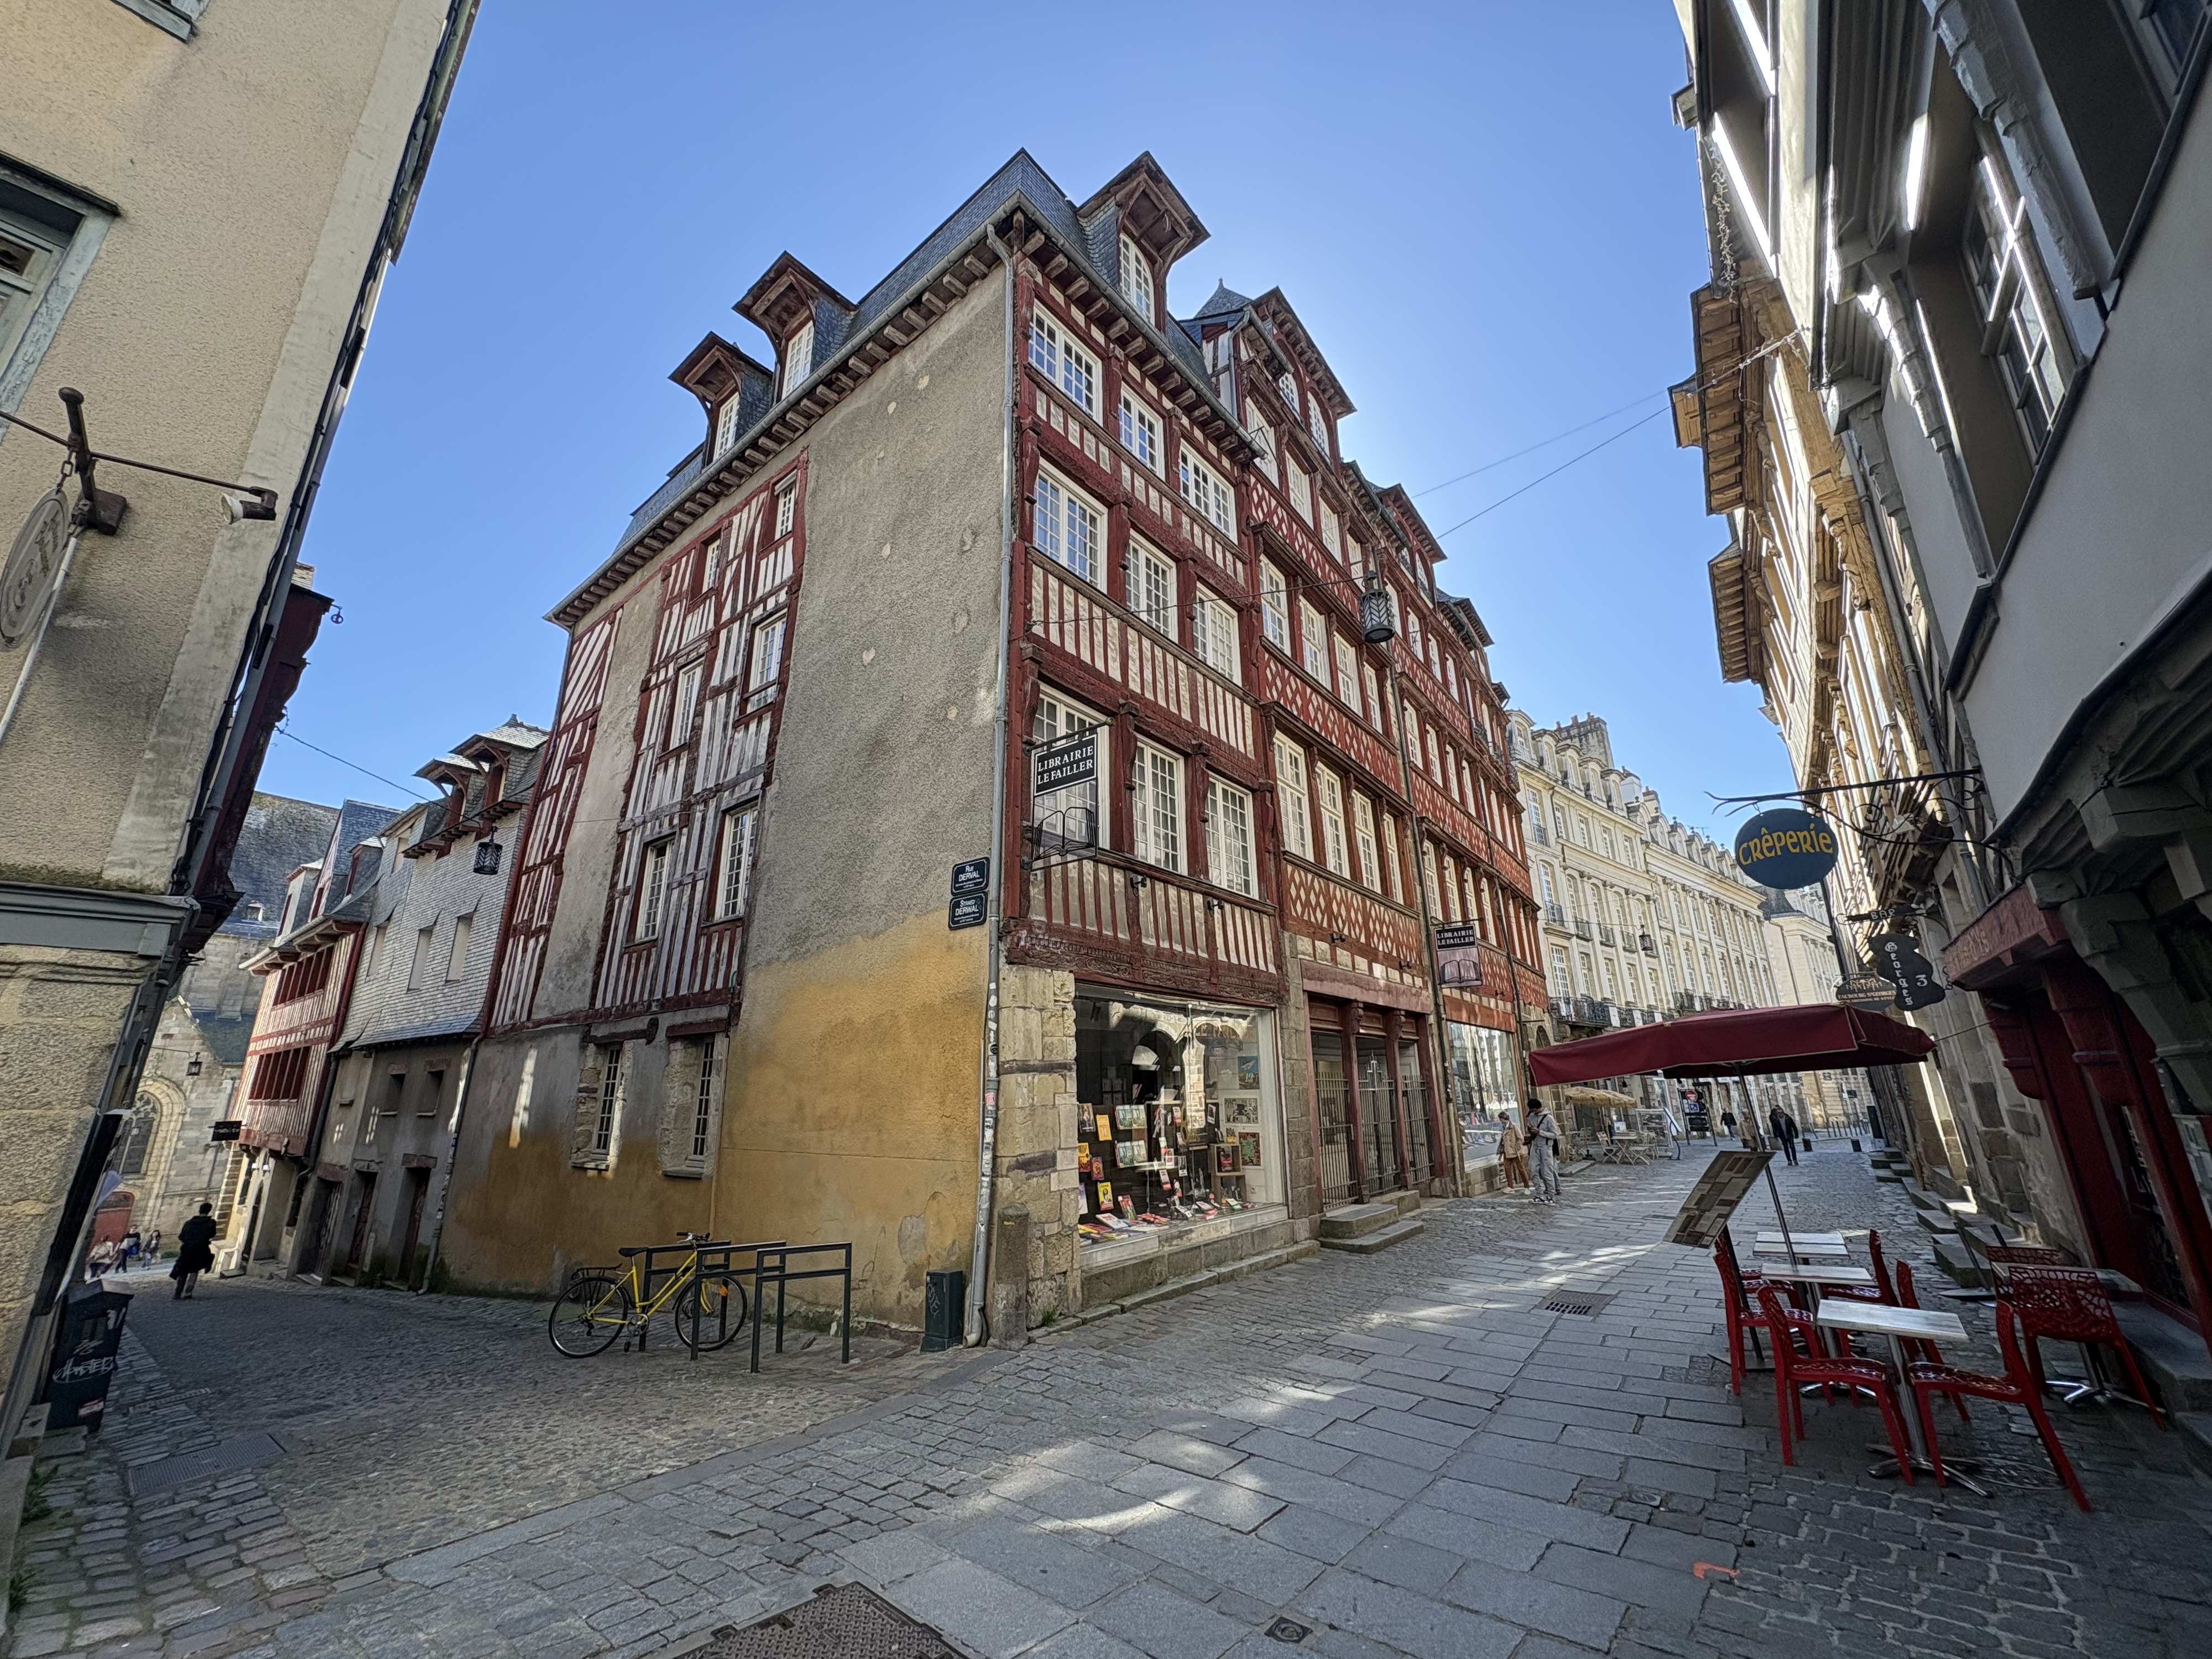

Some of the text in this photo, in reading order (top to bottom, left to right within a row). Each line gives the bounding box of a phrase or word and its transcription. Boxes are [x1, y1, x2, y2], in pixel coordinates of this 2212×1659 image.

[1038, 745, 1093, 772] LIBRAIRIE
[1037, 759, 1093, 785] LE FAILLER
[958, 870, 980, 881] DERVAL
[955, 905, 979, 916] DERWAL
[1870, 909, 1895, 919] BAR
[1437, 930, 1474, 938] LIBRAIRIE
[1447, 936, 1474, 945] FAILLER
[1885, 942, 1913, 1005] Georges
[1915, 974, 1928, 987] 3
